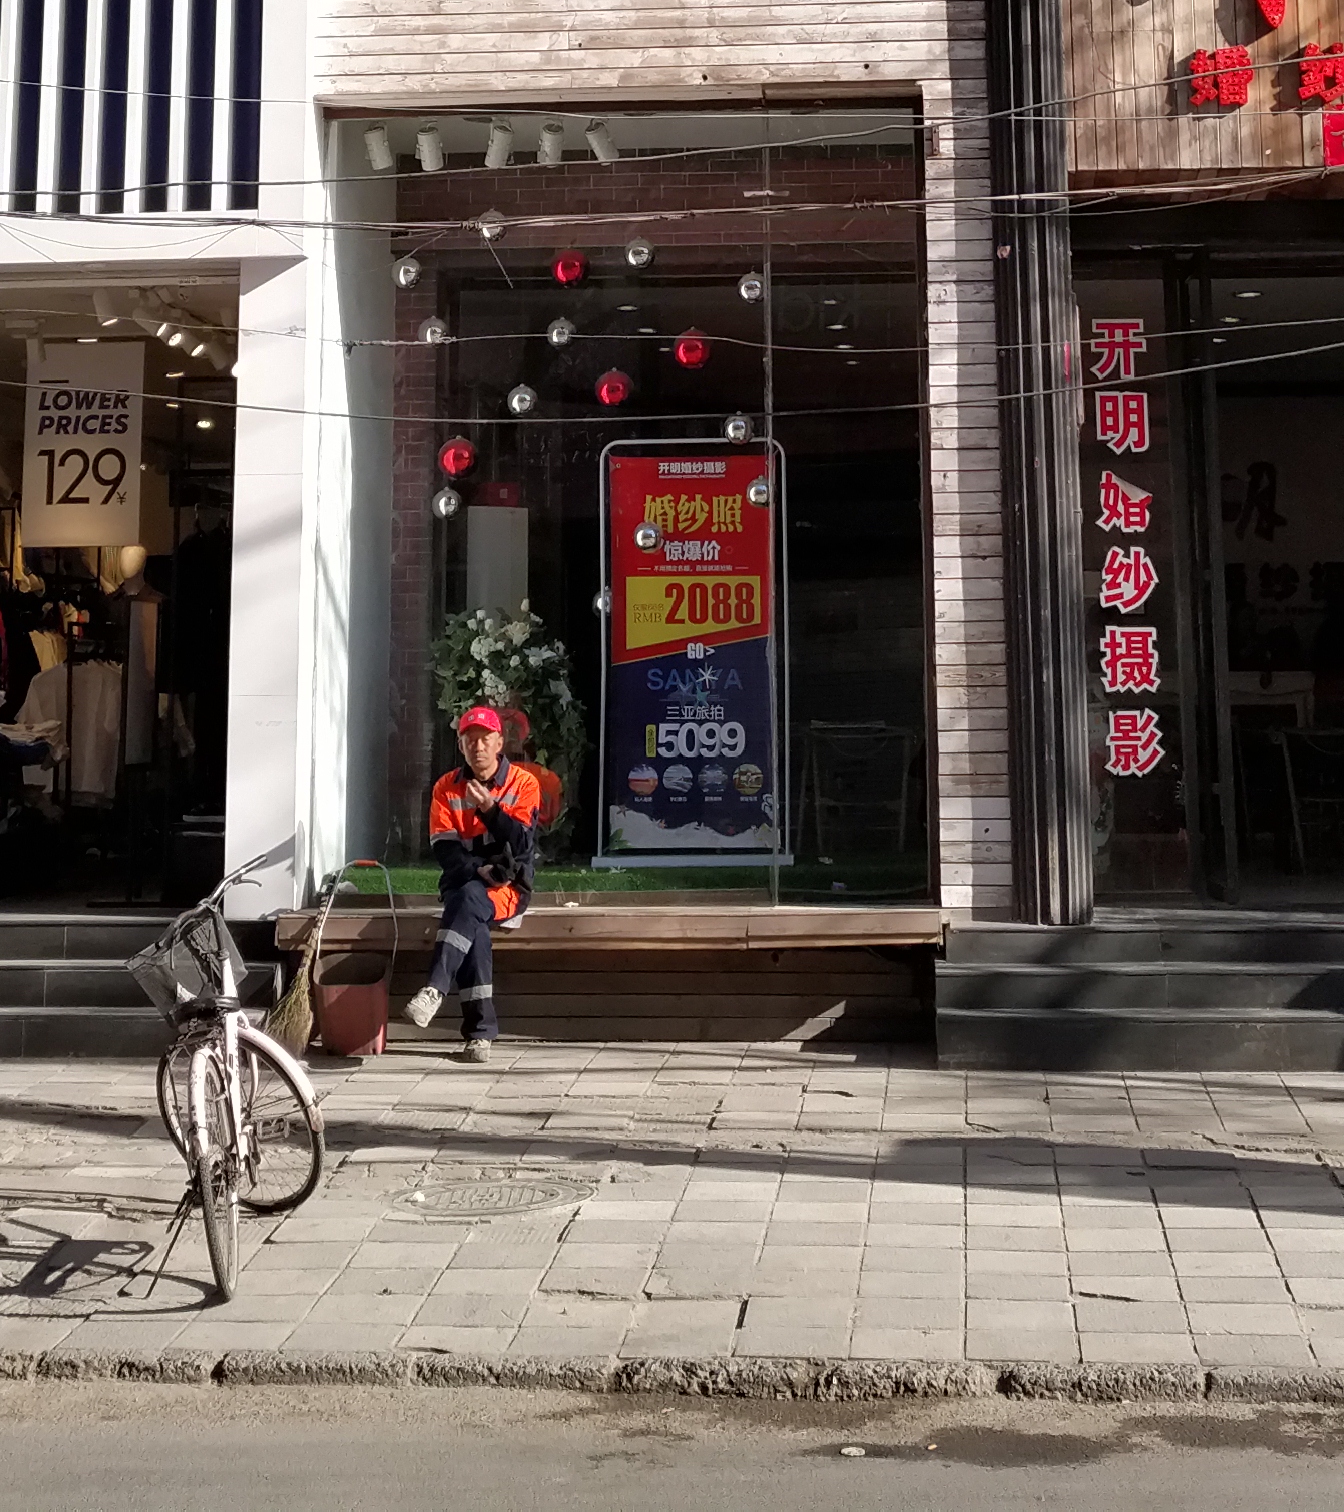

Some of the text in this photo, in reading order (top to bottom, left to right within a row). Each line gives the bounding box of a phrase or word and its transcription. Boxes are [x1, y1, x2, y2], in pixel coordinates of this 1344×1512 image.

[38, 388, 131, 411] LOWER
[37, 414, 130, 436] PRICES
[643, 494, 744, 534] 婚纱照
[663, 540, 721, 562] 惊爆价
[633, 581, 756, 625] RMB 2088
[665, 704, 725, 720] 三亚旅拍
[657, 721, 747, 758] 5099
